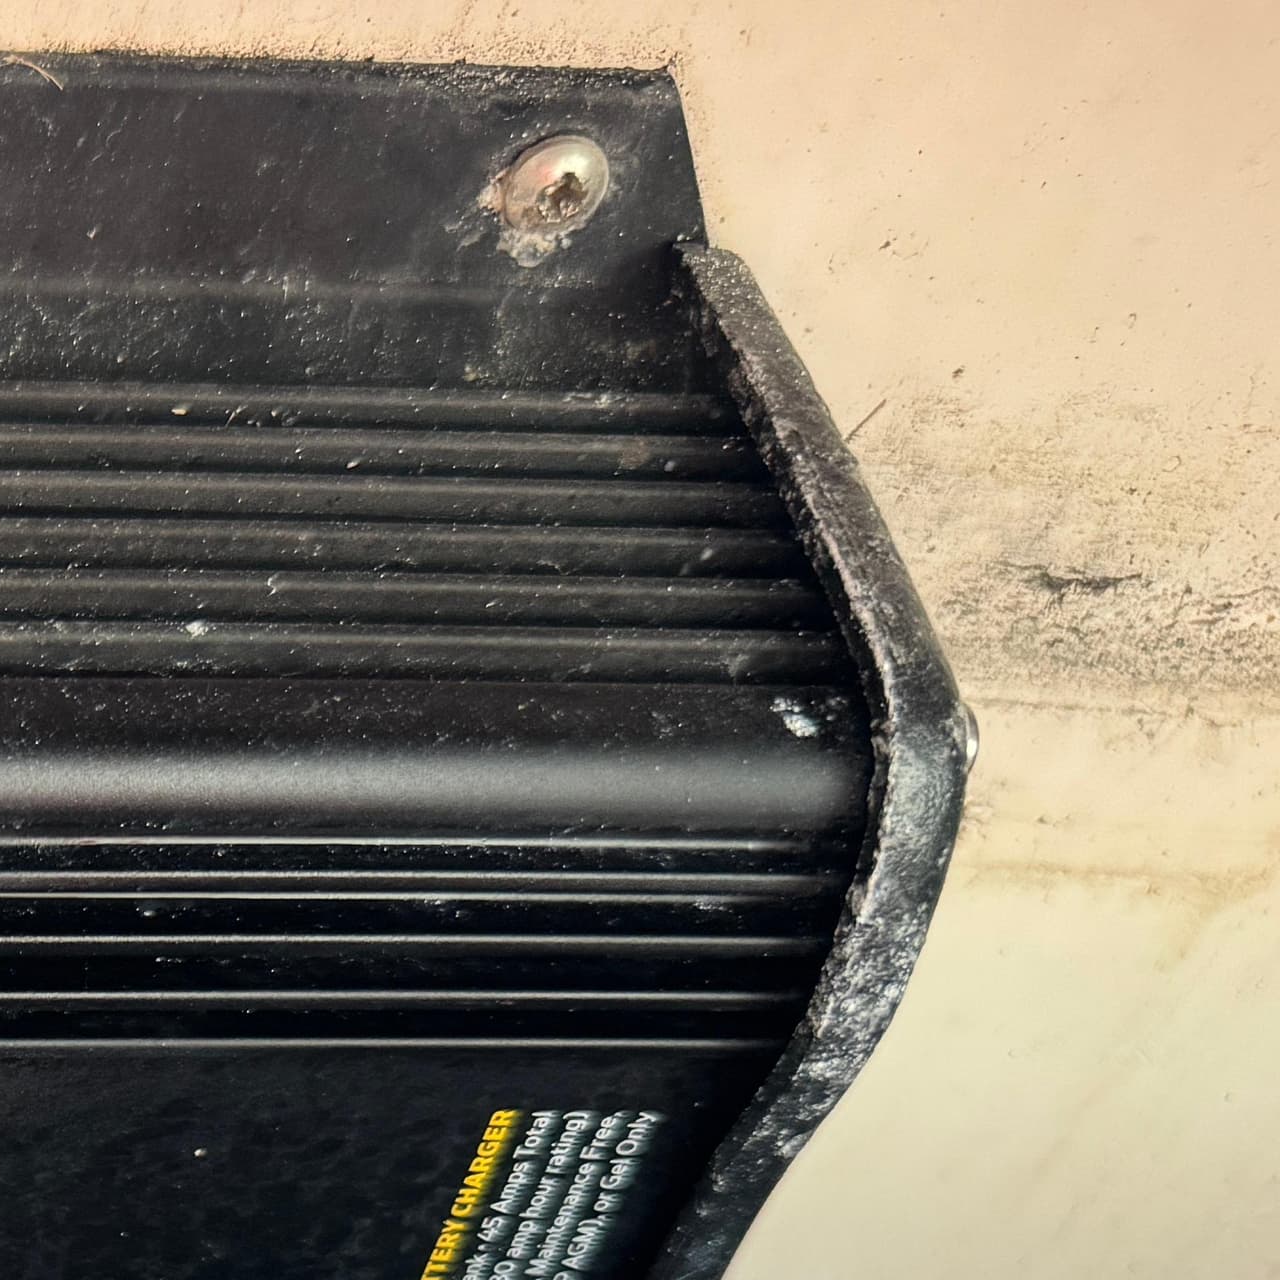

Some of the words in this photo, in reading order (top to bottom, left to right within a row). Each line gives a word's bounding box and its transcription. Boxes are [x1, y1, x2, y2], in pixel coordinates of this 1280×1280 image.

[513, 1110, 557, 1159] Total
[545, 1110, 594, 1173] rating)
[615, 1111, 659, 1156] Only
[451, 1109, 519, 1217] CHARGER
[599, 1158, 634, 1189] Gel
[490, 1161, 536, 1214] Amps
[519, 1173, 559, 1218] hour
[524, 1162, 598, 1275] Maintenance
[579, 1110, 628, 1160] Free,
[593, 1192, 617, 1212] or
[477, 1216, 506, 1242] 45
[506, 1220, 546, 1258] amp
